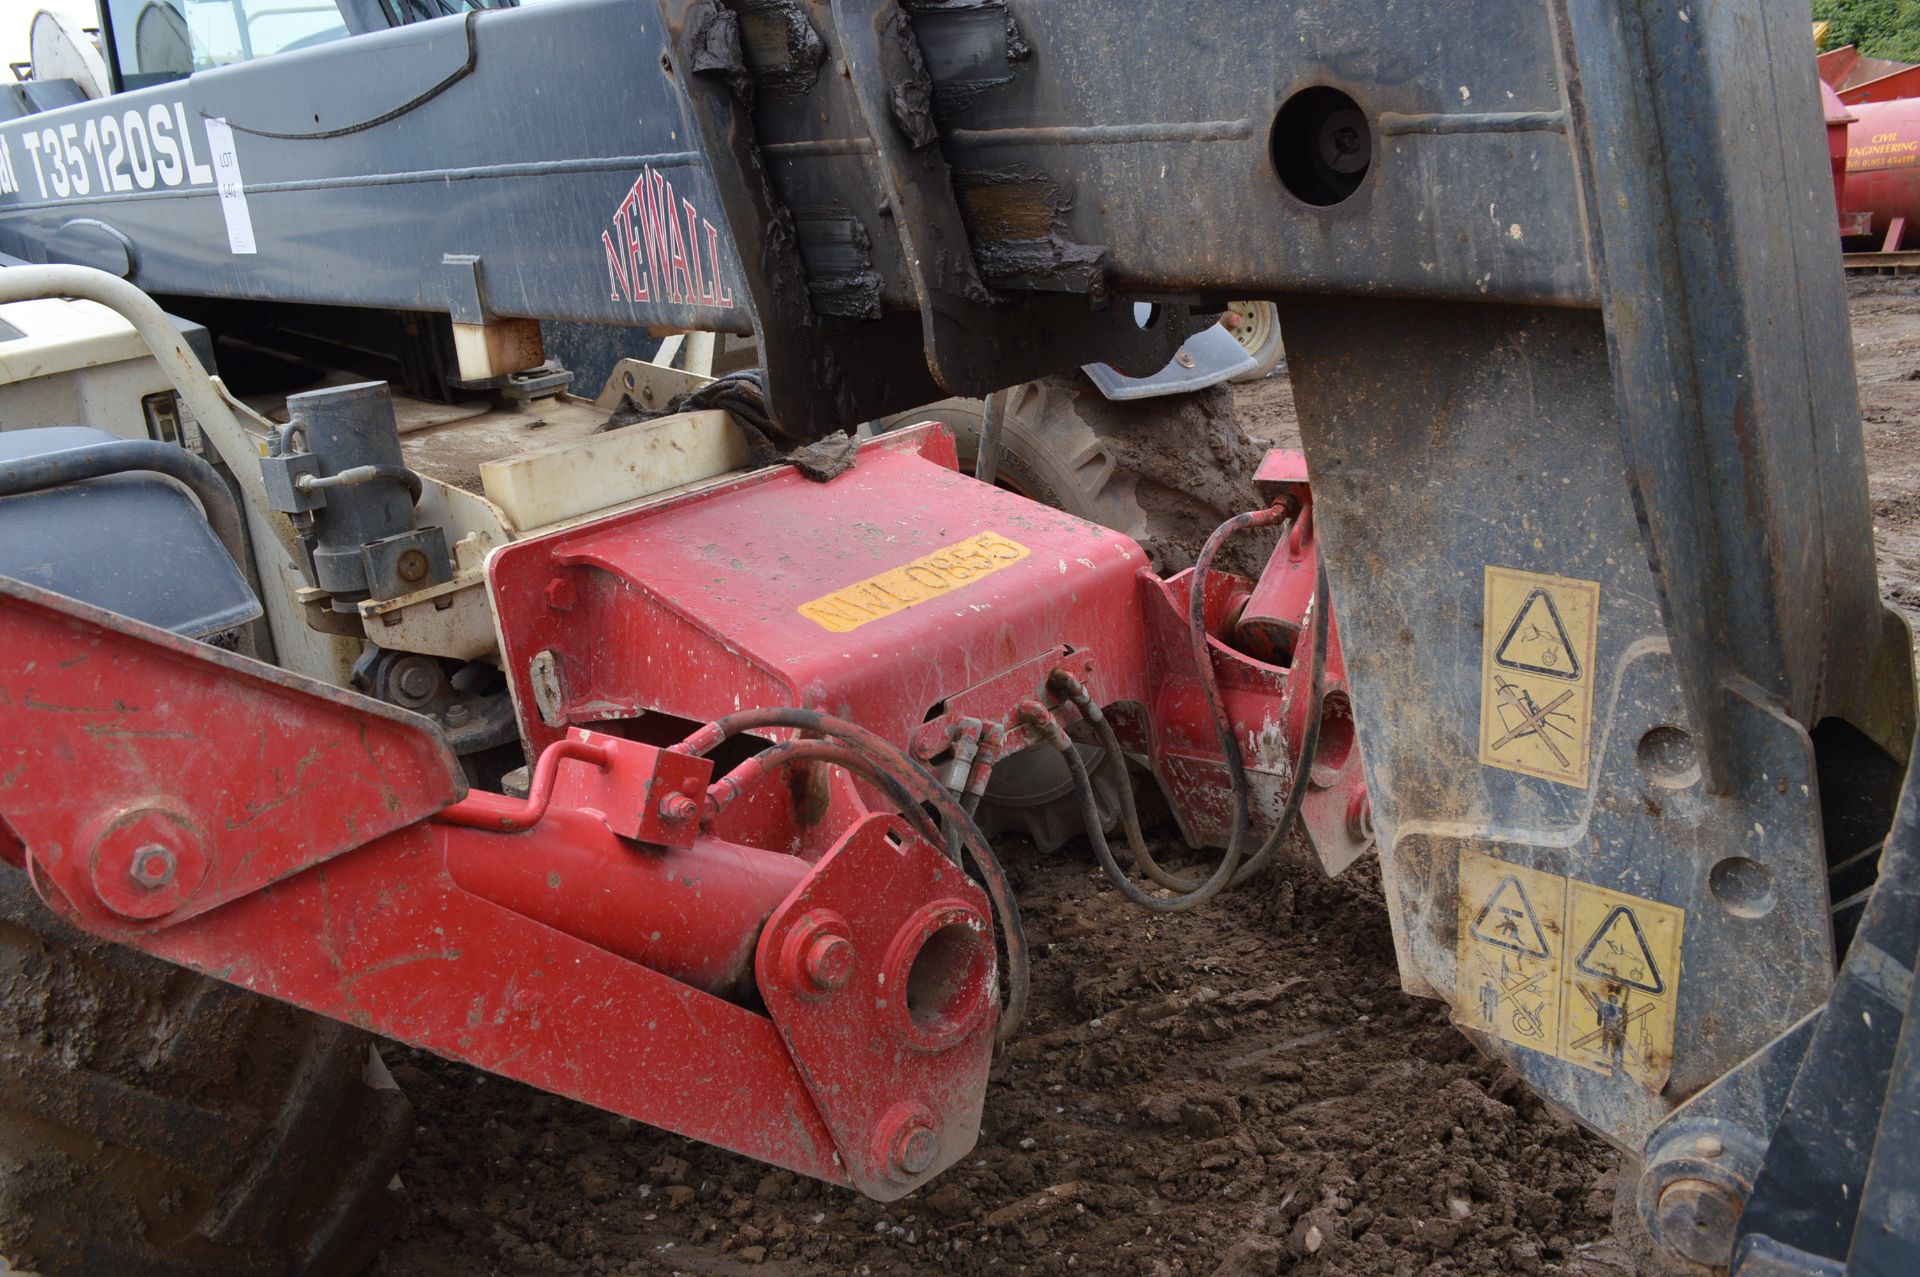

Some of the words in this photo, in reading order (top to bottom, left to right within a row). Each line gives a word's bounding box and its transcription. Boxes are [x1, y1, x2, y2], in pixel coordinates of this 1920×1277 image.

[23, 102, 213, 198] T35120SL
[1848, 141, 1918, 157] ENGINEERING
[1872, 132, 1898, 143] CIVIL
[219, 152, 233, 168] LOT
[602, 163, 733, 308] NEWALL
[904, 535, 1020, 588] 0855
